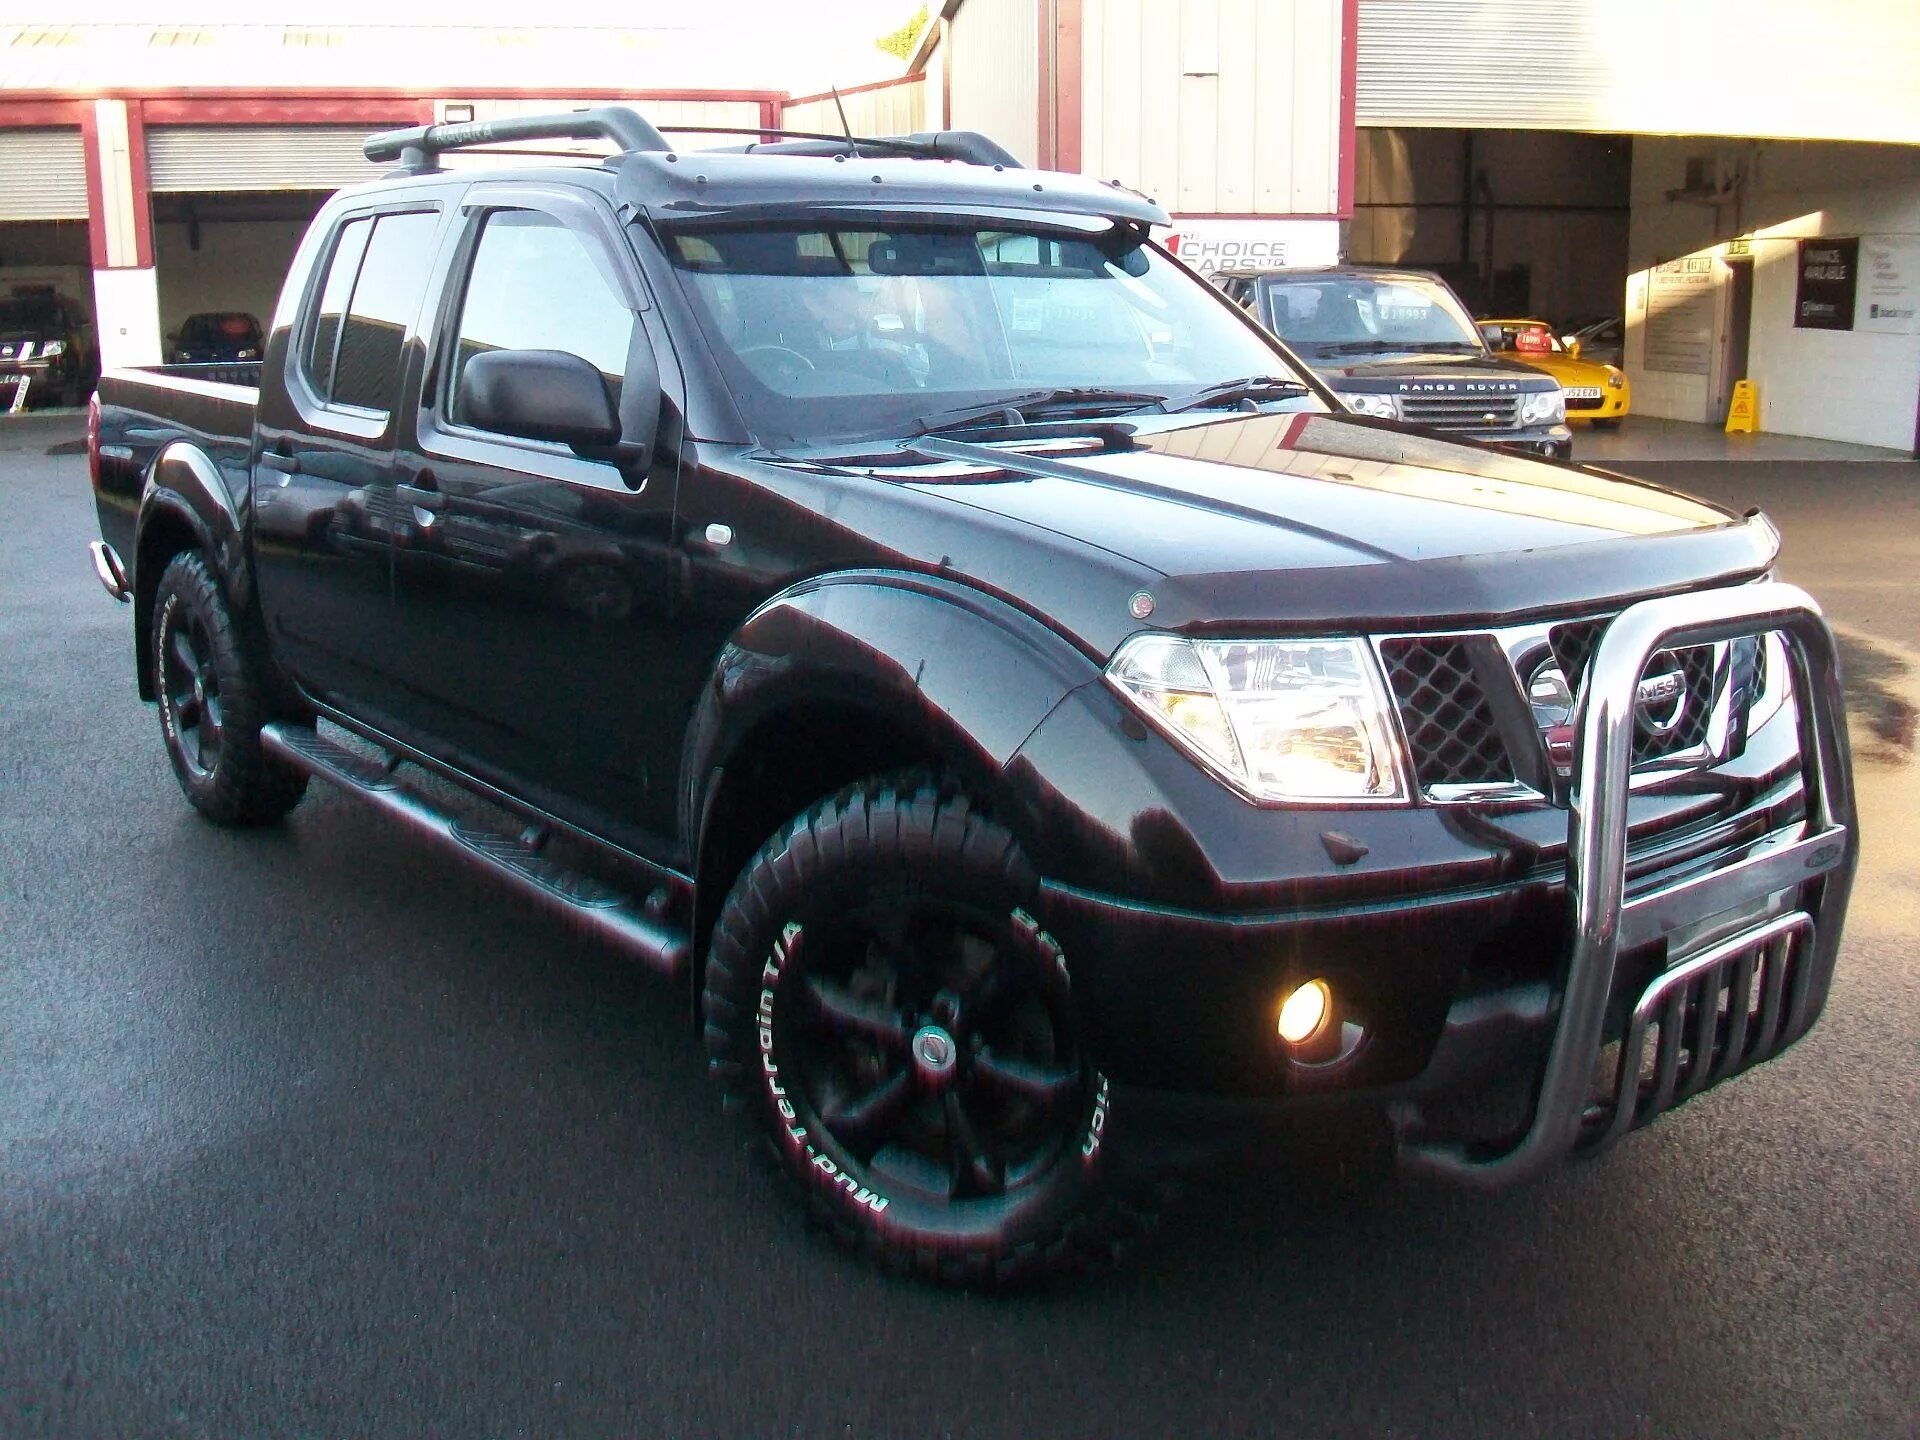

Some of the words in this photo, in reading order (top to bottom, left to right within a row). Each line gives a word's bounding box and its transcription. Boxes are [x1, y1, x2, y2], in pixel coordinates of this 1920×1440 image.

[1181, 242, 1287, 257] CHOICE
[1259, 259, 1287, 267] LTD
[1399, 384, 1456, 392] RANGE
[1466, 383, 1518, 391] ROVER
[1640, 678, 1683, 698] NISSA
[762, 921, 804, 978] T/A
[756, 988, 891, 1214] Mud-Terrain
